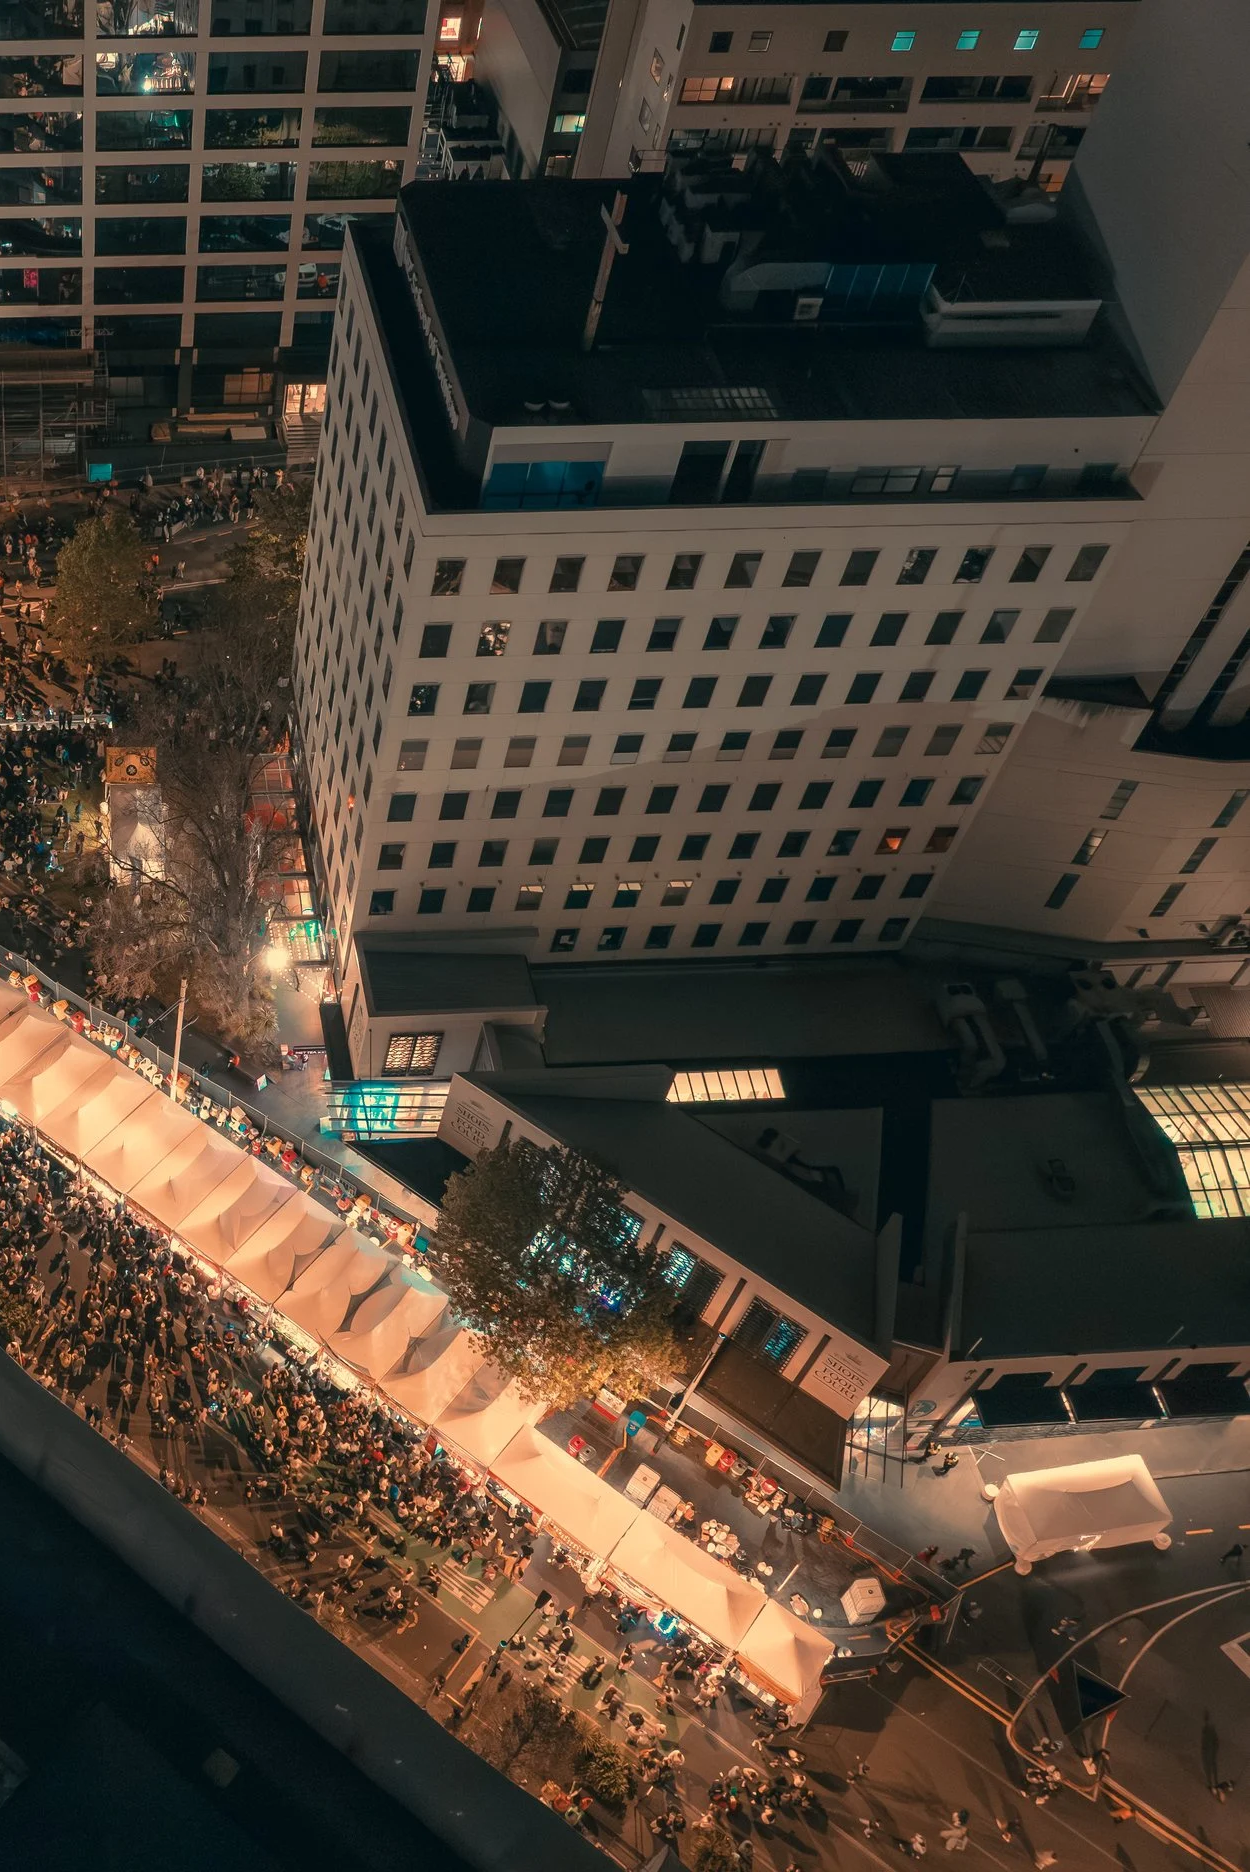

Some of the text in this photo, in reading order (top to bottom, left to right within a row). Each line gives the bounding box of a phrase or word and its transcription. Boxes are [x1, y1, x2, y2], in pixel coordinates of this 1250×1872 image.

[456, 1117, 485, 1139] FOOD
[457, 1106, 490, 1132] SHOPS
[450, 1121, 485, 1147] COURT
[814, 1371, 855, 1399] COURT
[823, 1367, 857, 1392] FOOD
[826, 1358, 864, 1386] SHOPS
